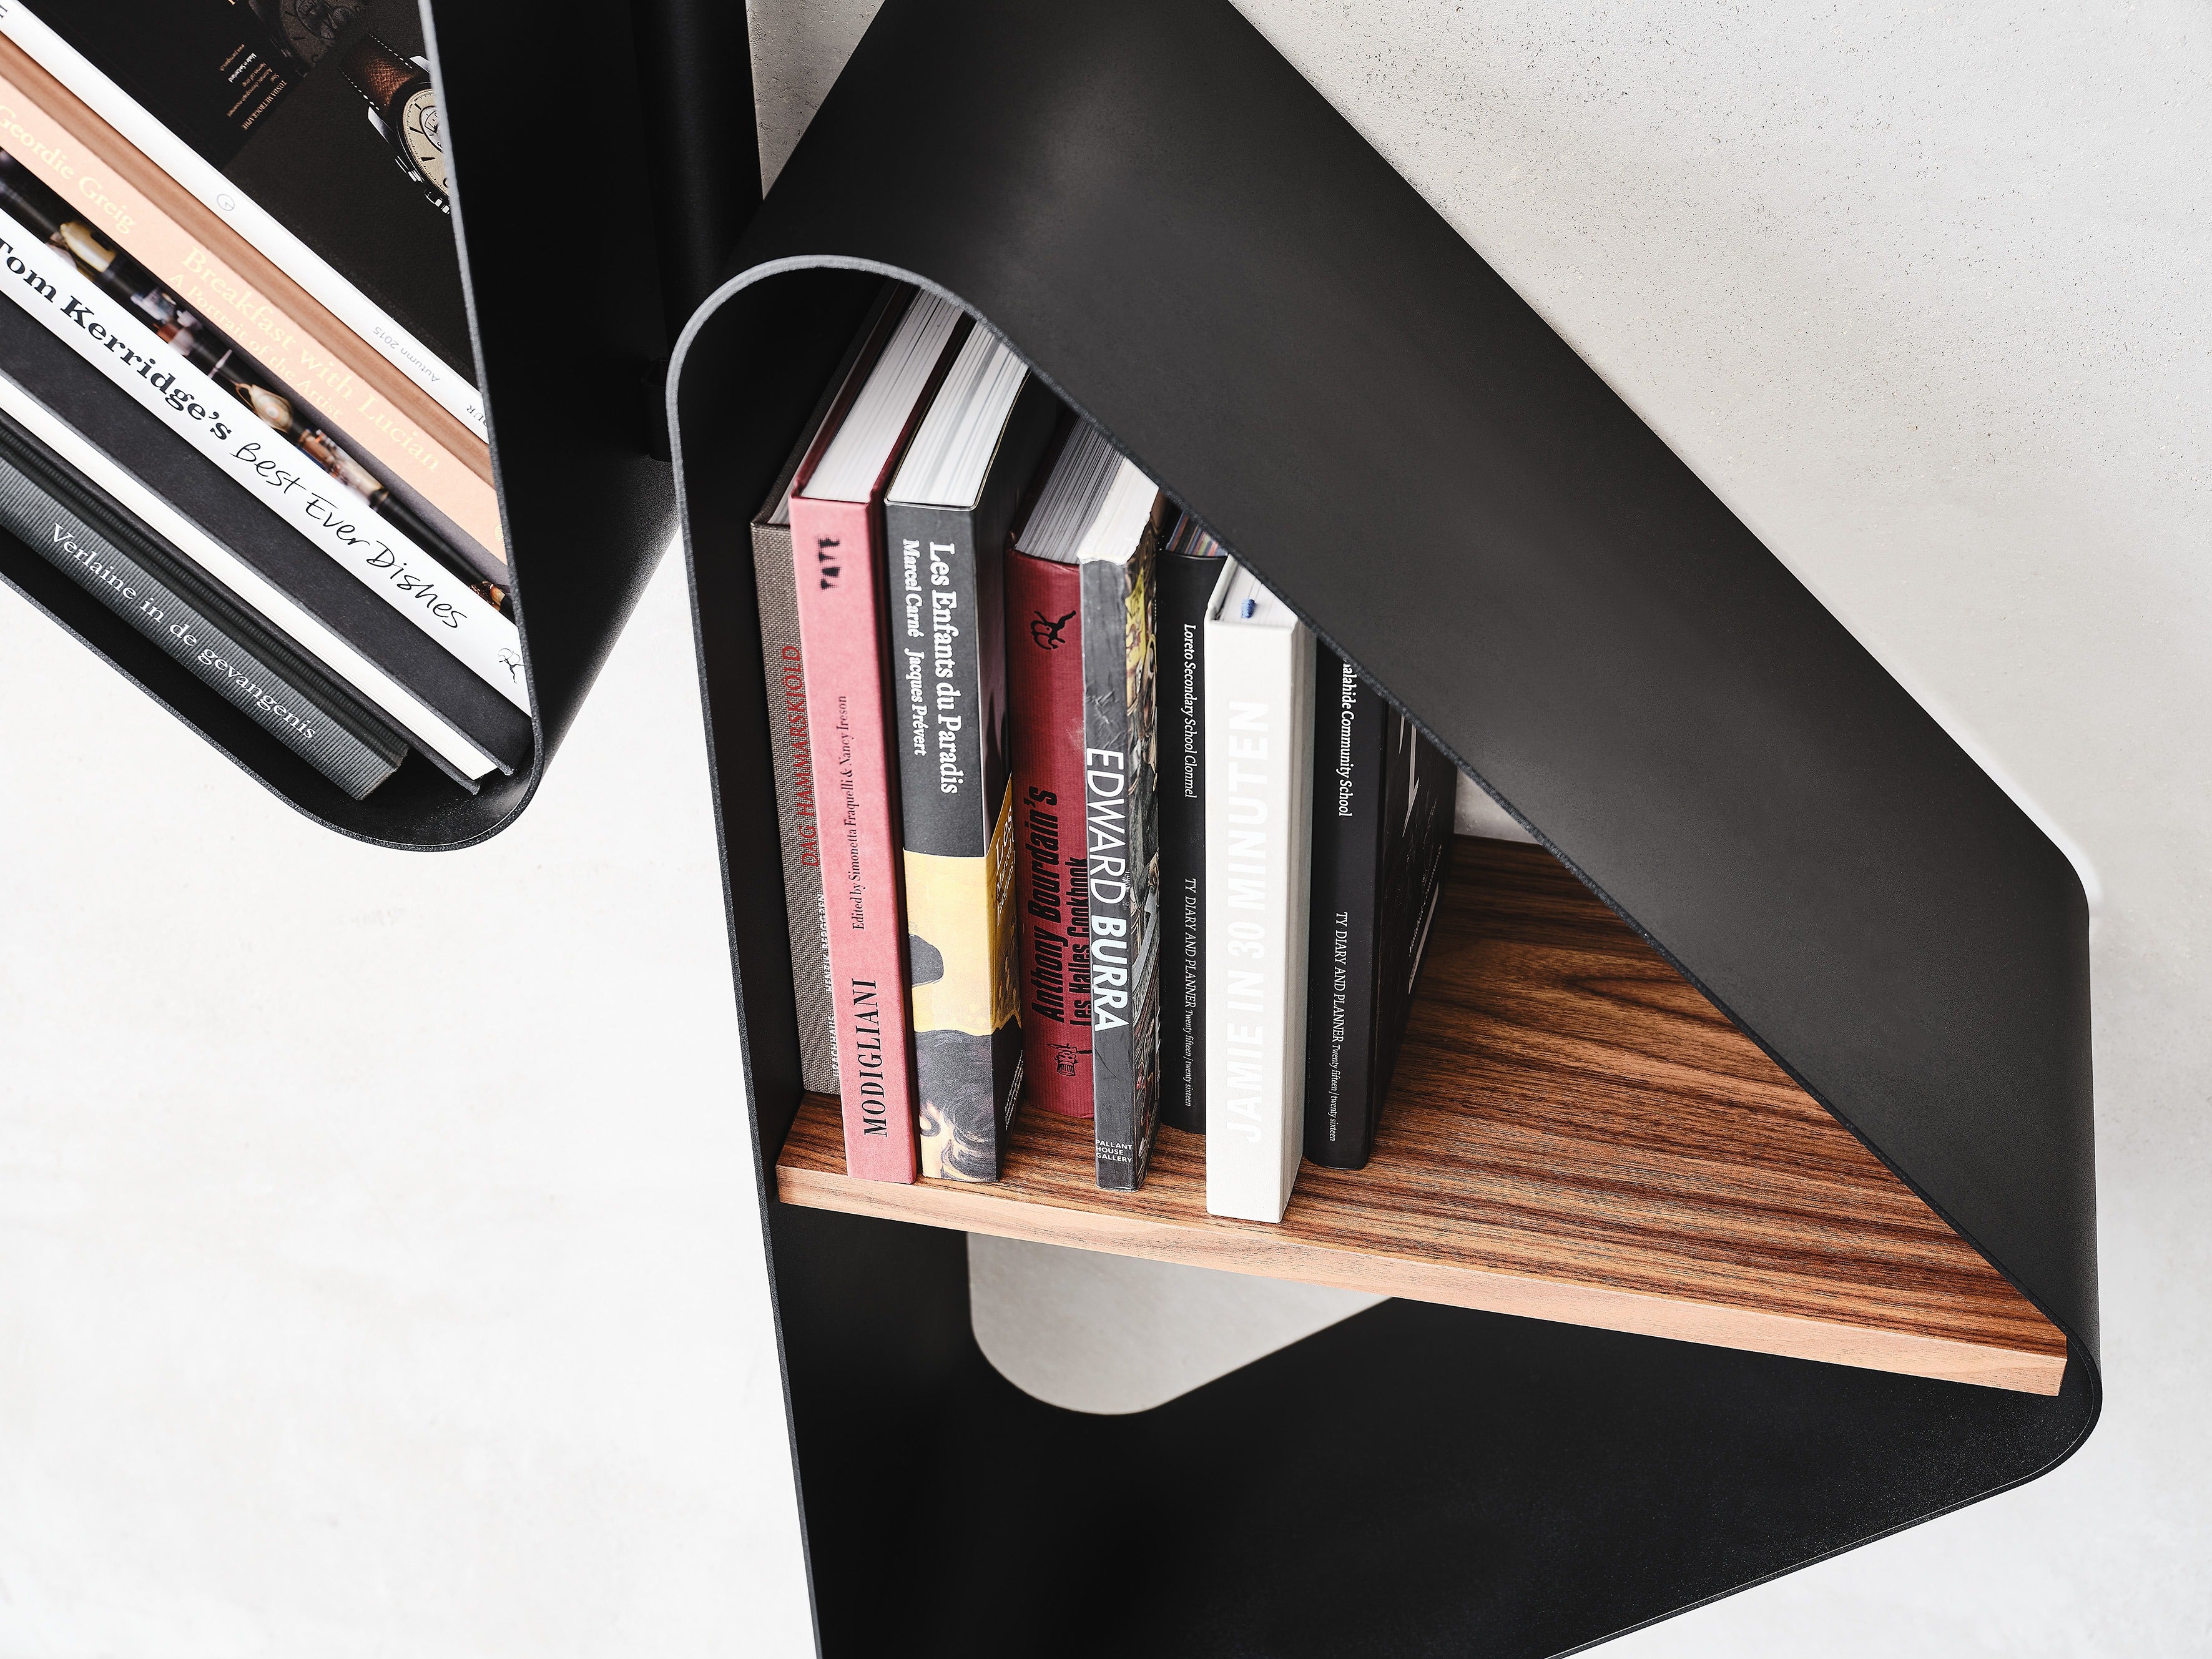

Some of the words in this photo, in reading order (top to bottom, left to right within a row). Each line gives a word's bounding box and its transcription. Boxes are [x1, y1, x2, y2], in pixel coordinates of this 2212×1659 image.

[228, 64, 246, 82] Switzerland
[246, 52, 257, 62] Made
[270, 80, 287, 96] TONDA
[242, 96, 273, 129] METROGRAPHE
[78, 175, 137, 234] Greig
[168, 273, 184, 288] A
[187, 285, 248, 341] Portrait
[248, 340, 274, 357] of
[268, 356, 296, 380] the
[295, 379, 343, 419] Artist
[372, 326, 400, 349] 2015
[59, 295, 232, 440] Kerridge's
[180, 245, 297, 350] Breakfast
[300, 348, 353, 401] with
[356, 392, 439, 473] Lucian
[400, 347, 440, 382] Autumn
[818, 538, 840, 590] TATE
[902, 538, 922, 591] Marcel
[929, 541, 955, 586] Les
[53, 522, 136, 599] Verlaine
[139, 597, 164, 623] in
[169, 623, 197, 646] de
[197, 649, 316, 739] gevangenis
[905, 593, 925, 638] Carné
[931, 589, 959, 678] Enfants
[1184, 623, 1196, 660] Loreto
[903, 647, 925, 702] Jacques
[1180, 661, 1197, 717] Secondary
[835, 696, 849, 730] Ireson
[935, 682, 961, 711] du
[782, 646, 814, 816] HAMMARSKJÖLD
[911, 703, 929, 756] Prévert
[1184, 717, 1197, 754] School
[1335, 710, 1355, 779] Community
[838, 732, 854, 766] Nancy
[937, 713, 965, 794] Paradis
[840, 769, 853, 777] &
[1184, 755, 1197, 798] Clonmel
[840, 779, 860, 826] Fraquelli
[1227, 700, 1268, 909] MINUTEN
[1338, 779, 1354, 817] School
[1086, 747, 1126, 905] EDWARD
[800, 825, 818, 866] DAG
[847, 829, 861, 881] Simonetta
[1023, 785, 1058, 925] Bourdain's
[848, 882, 866, 895] by
[1064, 856, 1090, 939] Cookbook
[1184, 878, 1196, 893] TY
[849, 897, 865, 930] Edited
[1184, 895, 1196, 932] DIARY
[1335, 911, 1348, 927] TY
[1184, 932, 1196, 957] AND
[1227, 922, 1266, 958] 30
[1334, 929, 1347, 965] DIARY
[1030, 925, 1068, 1025] Anthony
[1066, 944, 1091, 994] Halles
[1090, 914, 1129, 1031] BURRA
[1184, 958, 1196, 1008] PLANNER
[1334, 966, 1346, 992] AND
[1226, 970, 1264, 1009] IN
[1069, 1000, 1092, 1026] Les
[1182, 1010, 1193, 1035] Twenty
[1332, 993, 1345, 1043] PLANNER
[851, 978, 887, 1138] MODIGLIANI
[1184, 1034, 1194, 1056] fifteen
[1329, 1043, 1340, 1070] Twenty
[1182, 1060, 1192, 1084] twenty
[1224, 1021, 1264, 1141] JAMIE
[1330, 1069, 1341, 1091] fifteen
[1184, 1083, 1194, 1106] sixteen
[1327, 1095, 1338, 1118] twenty
[1095, 1138, 1133, 1150] PALLANT
[1329, 1118, 1339, 1141] sixteen
[1094, 1145, 1124, 1156] HOUSE
[1094, 1151, 1133, 1163] GALLERY
